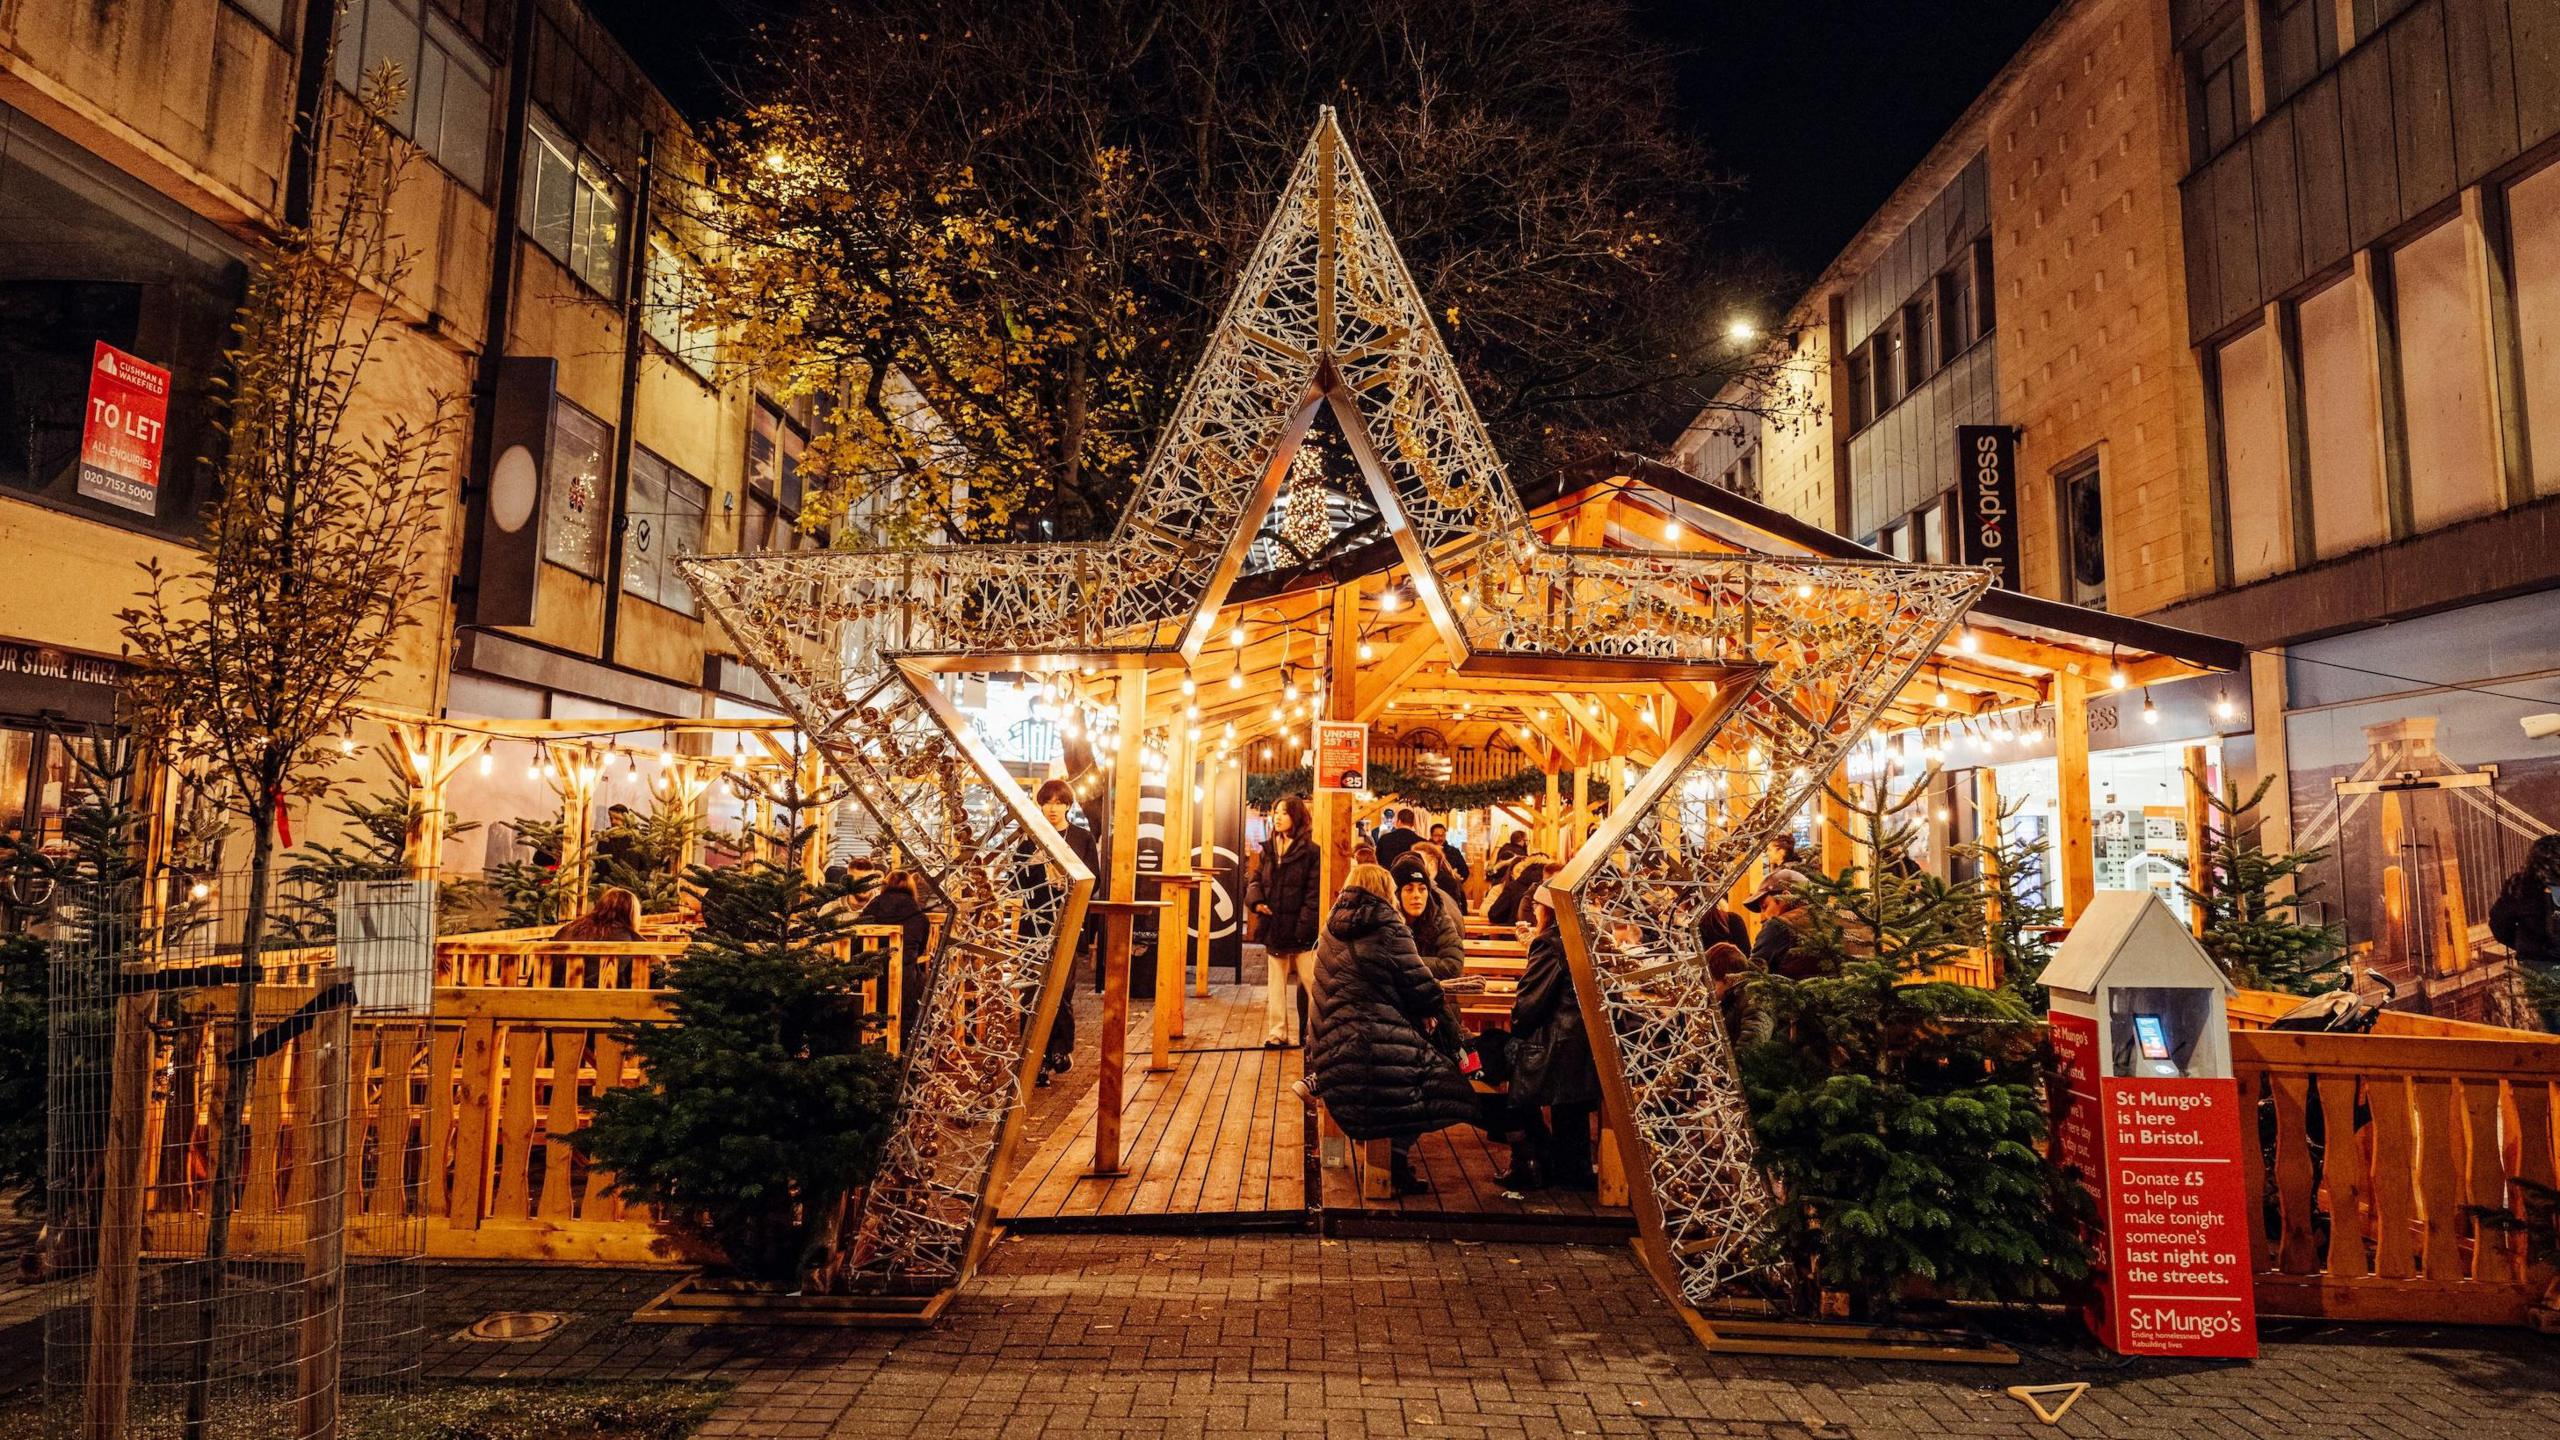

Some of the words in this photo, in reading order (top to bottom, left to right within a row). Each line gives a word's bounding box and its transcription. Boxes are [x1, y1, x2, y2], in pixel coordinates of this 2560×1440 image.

[119, 370, 163, 394] WAKEFIELD
[120, 362, 157, 383] CUSHMAN
[93, 397, 120, 429] TO
[125, 411, 161, 444] LET
[92, 440, 108, 455] ALL
[109, 446, 153, 470] ENQUIRIES
[84, 470, 103, 485] 020
[105, 477, 127, 493] 7152
[128, 484, 153, 501] 5000
[1976, 435, 2007, 548] express
[21, 650, 68, 679] STORE
[72, 659, 117, 685] HERE?
[1324, 730, 1360, 739] UNDER
[1347, 777, 1362, 788] 25
[2061, 1026, 2089, 1047] Mungo's
[2116, 1091, 2136, 1106] St
[2140, 1091, 2212, 1111] Mungo's
[2117, 1110, 2131, 1125] is
[2135, 1110, 2176, 1125] here
[2119, 1129, 2135, 1144] in
[2140, 1129, 2204, 1145] Bristol.
[2122, 1170, 2180, 1186] Donate
[2184, 1171, 2204, 1187] £5
[2123, 1192, 2140, 1205] to
[2145, 1190, 2177, 1209] help
[2182, 1194, 2199, 1205] us
[2124, 1209, 2165, 1224] make
[2169, 1210, 2225, 1229] tonight
[2126, 1229, 2206, 1245] someone's
[2127, 1247, 2158, 1263] last
[2163, 1249, 2209, 1268] night
[2213, 1253, 2236, 1264] on
[2128, 1267, 2158, 1282] the
[2163, 1270, 2229, 1285] streets.
[2130, 1307, 2152, 1330] St
[2155, 1308, 2242, 1338] Mungo's
[2131, 1331, 2154, 1340] Ending
[2155, 1332, 2200, 1340] homelessness
[2132, 1340, 2167, 1350] Rebuilding
